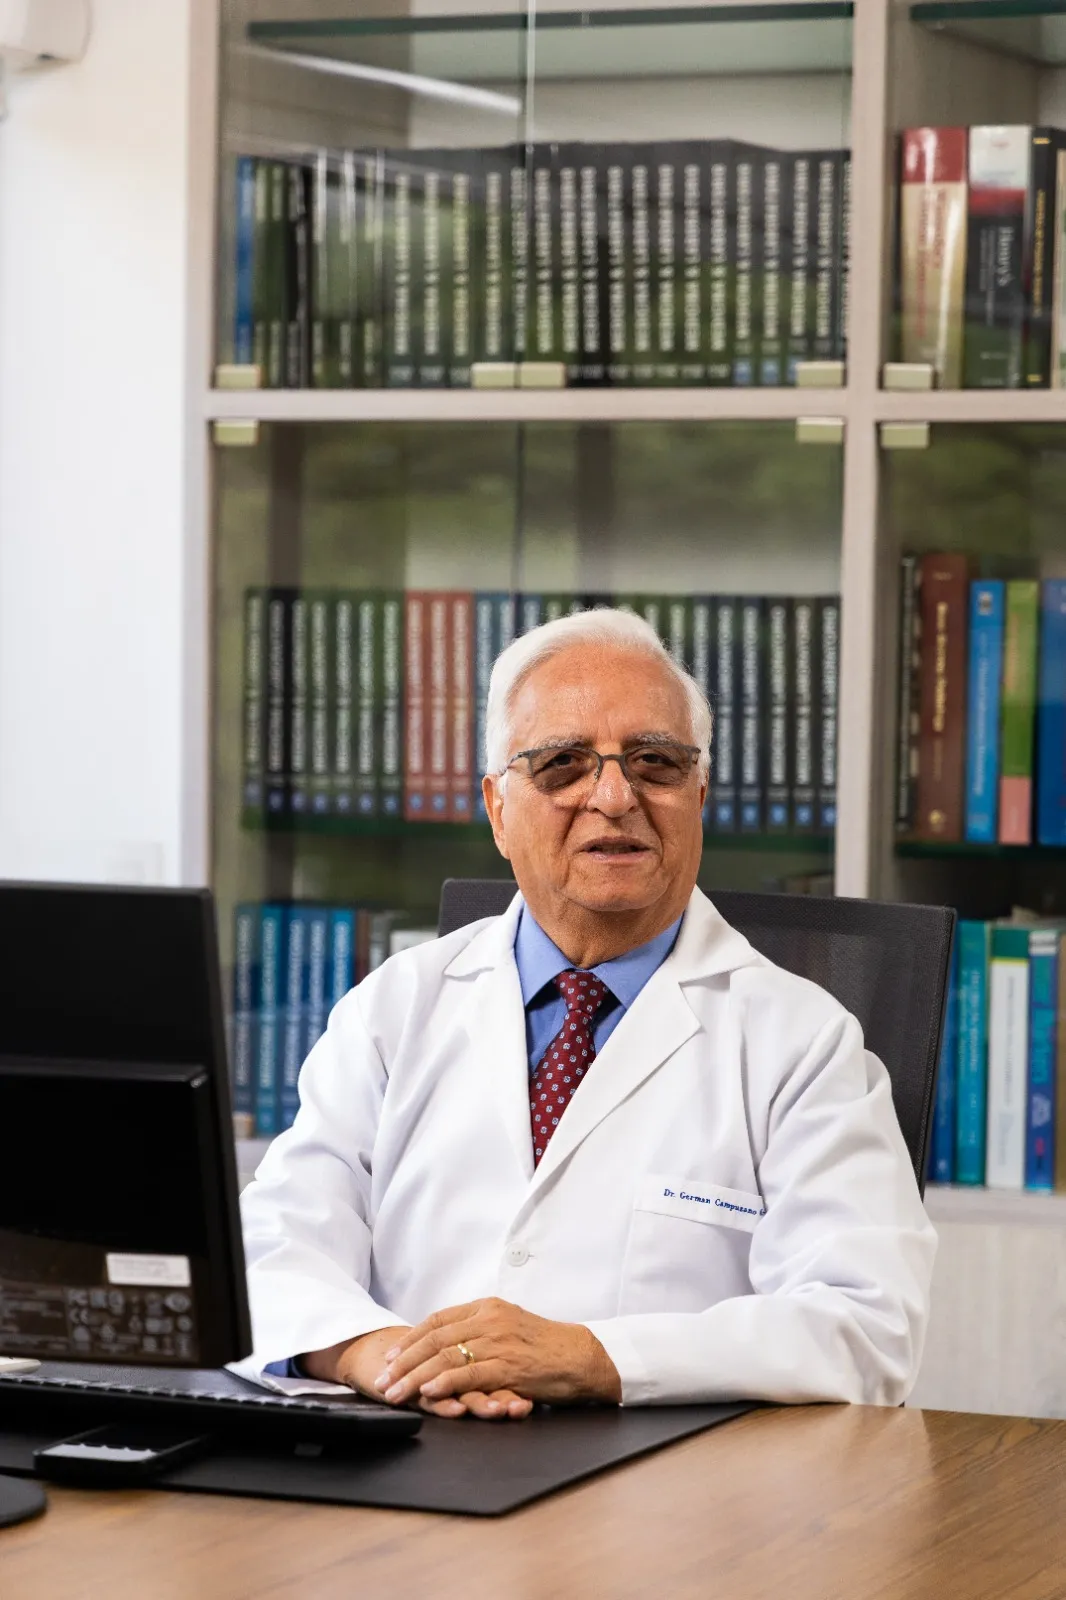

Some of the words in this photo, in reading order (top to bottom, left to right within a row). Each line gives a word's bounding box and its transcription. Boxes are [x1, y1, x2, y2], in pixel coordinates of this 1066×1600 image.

[663, 1188, 676, 1198] Dr.
[680, 1191, 711, 1204] German
[715, 1198, 757, 1215] Campuzano
